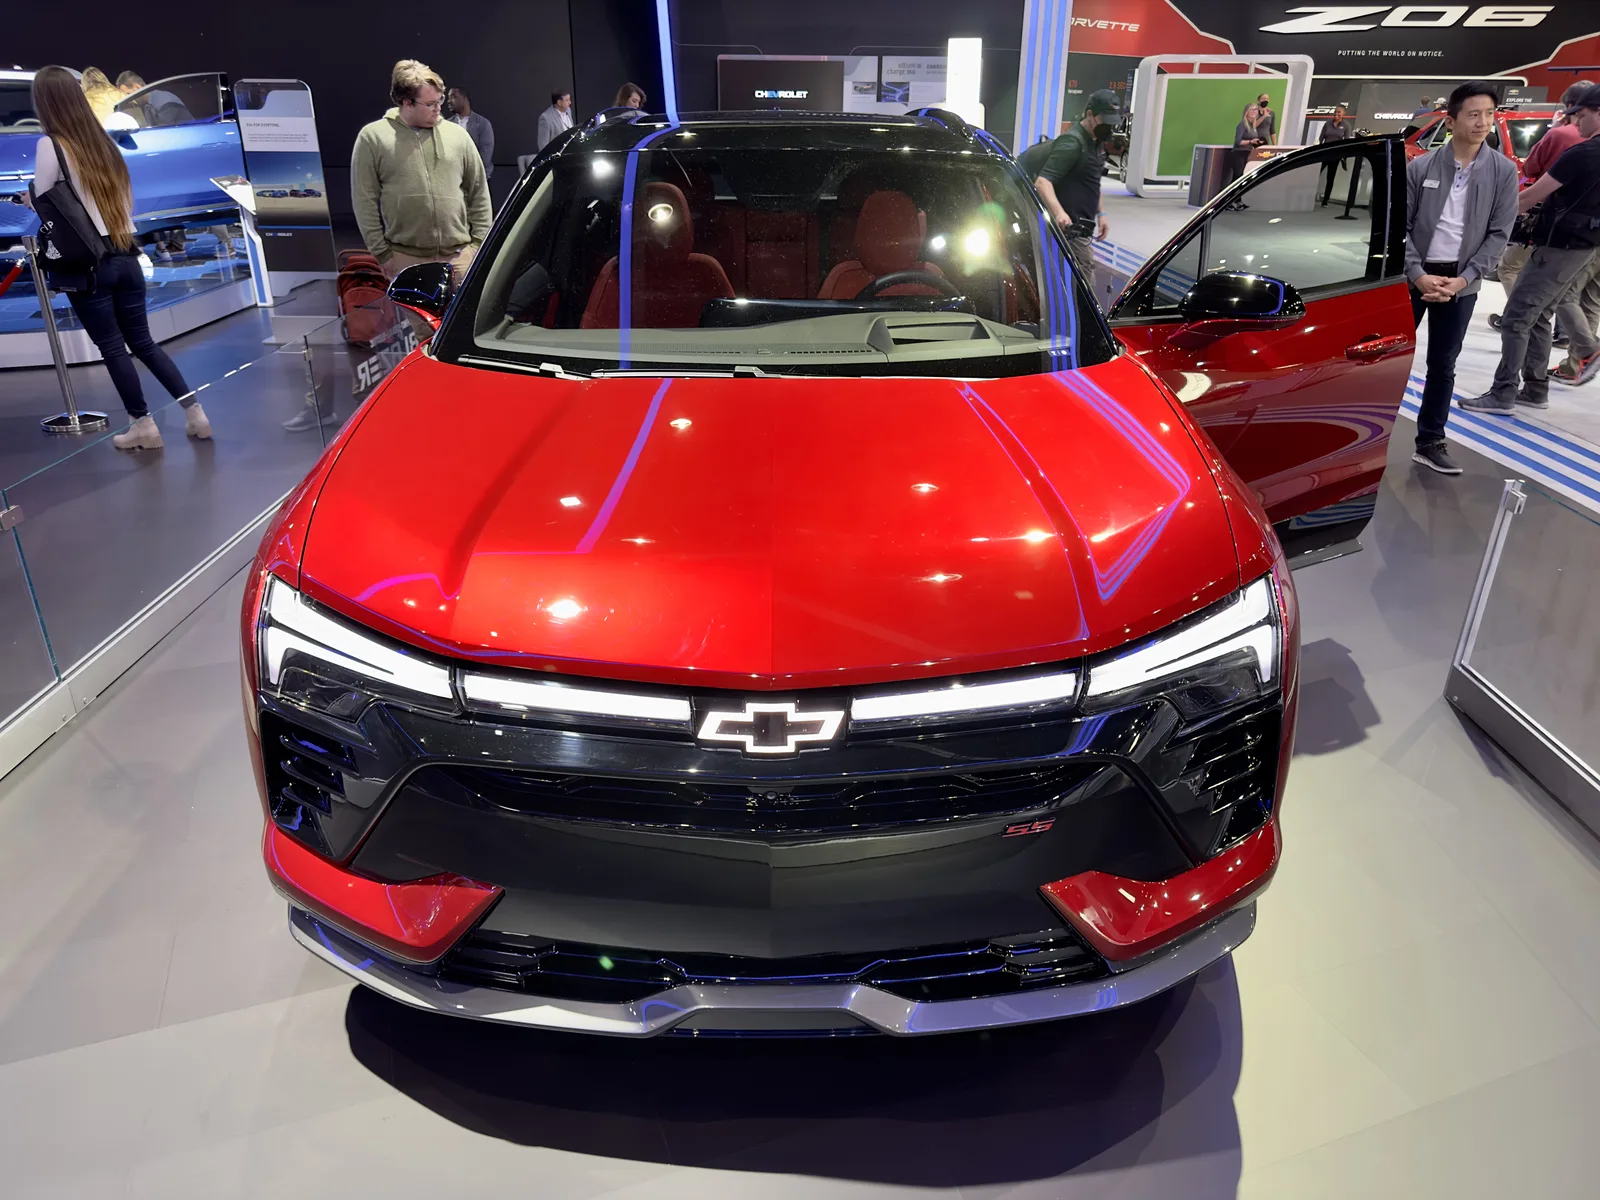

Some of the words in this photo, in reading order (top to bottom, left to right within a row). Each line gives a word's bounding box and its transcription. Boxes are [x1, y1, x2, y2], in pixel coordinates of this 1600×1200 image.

[1070, 17, 1140, 32] RVETTE
[754, 90, 809, 99] CHEVROLET
[1002, 817, 1057, 838] SS
